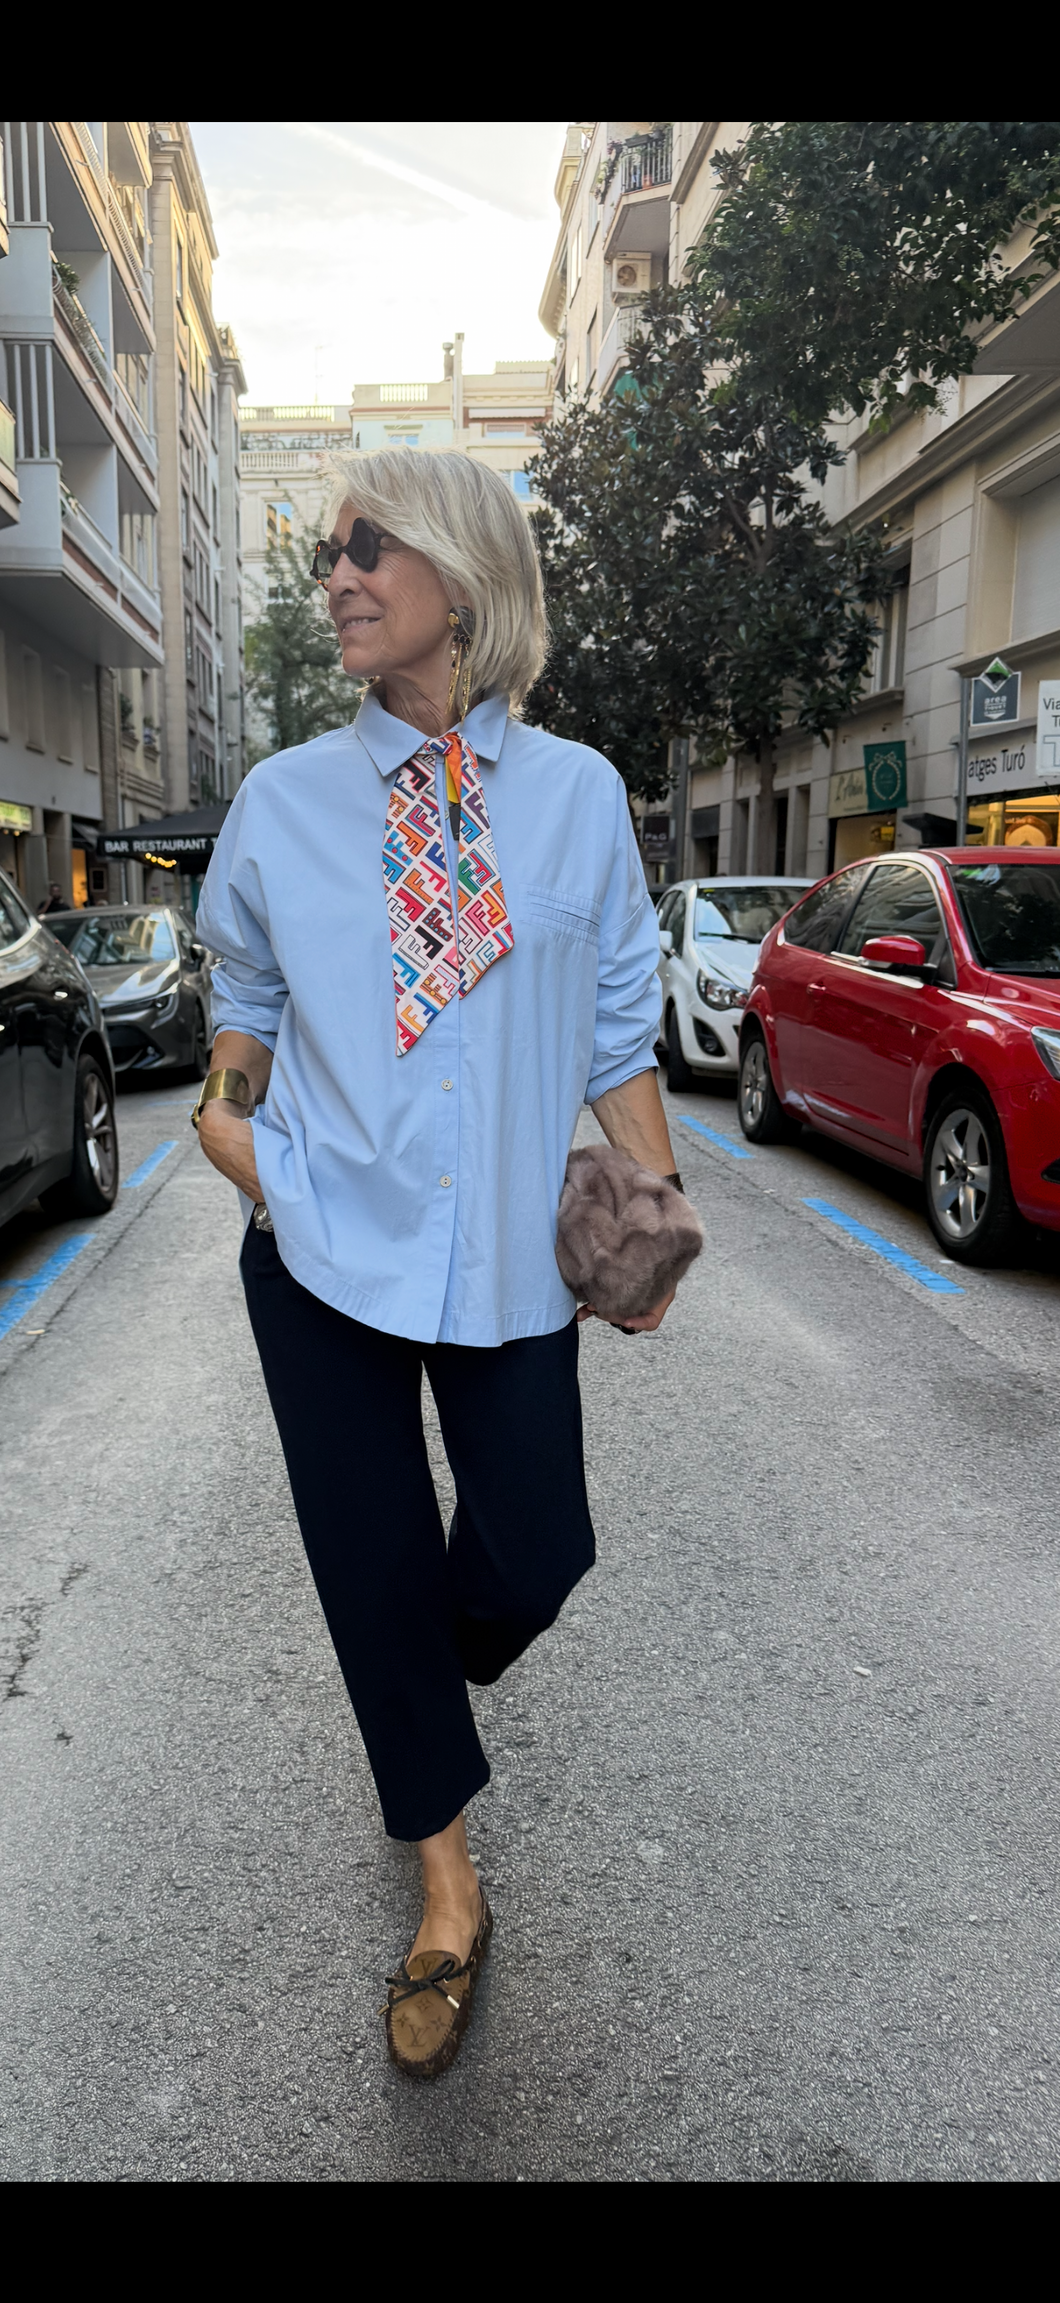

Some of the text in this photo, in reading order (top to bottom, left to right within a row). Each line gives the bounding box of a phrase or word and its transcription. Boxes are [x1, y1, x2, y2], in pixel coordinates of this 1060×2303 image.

[968, 744, 1026, 782] atges Turó
[104, 841, 129, 853] BAR
[133, 838, 207, 852] RESTAURANT
